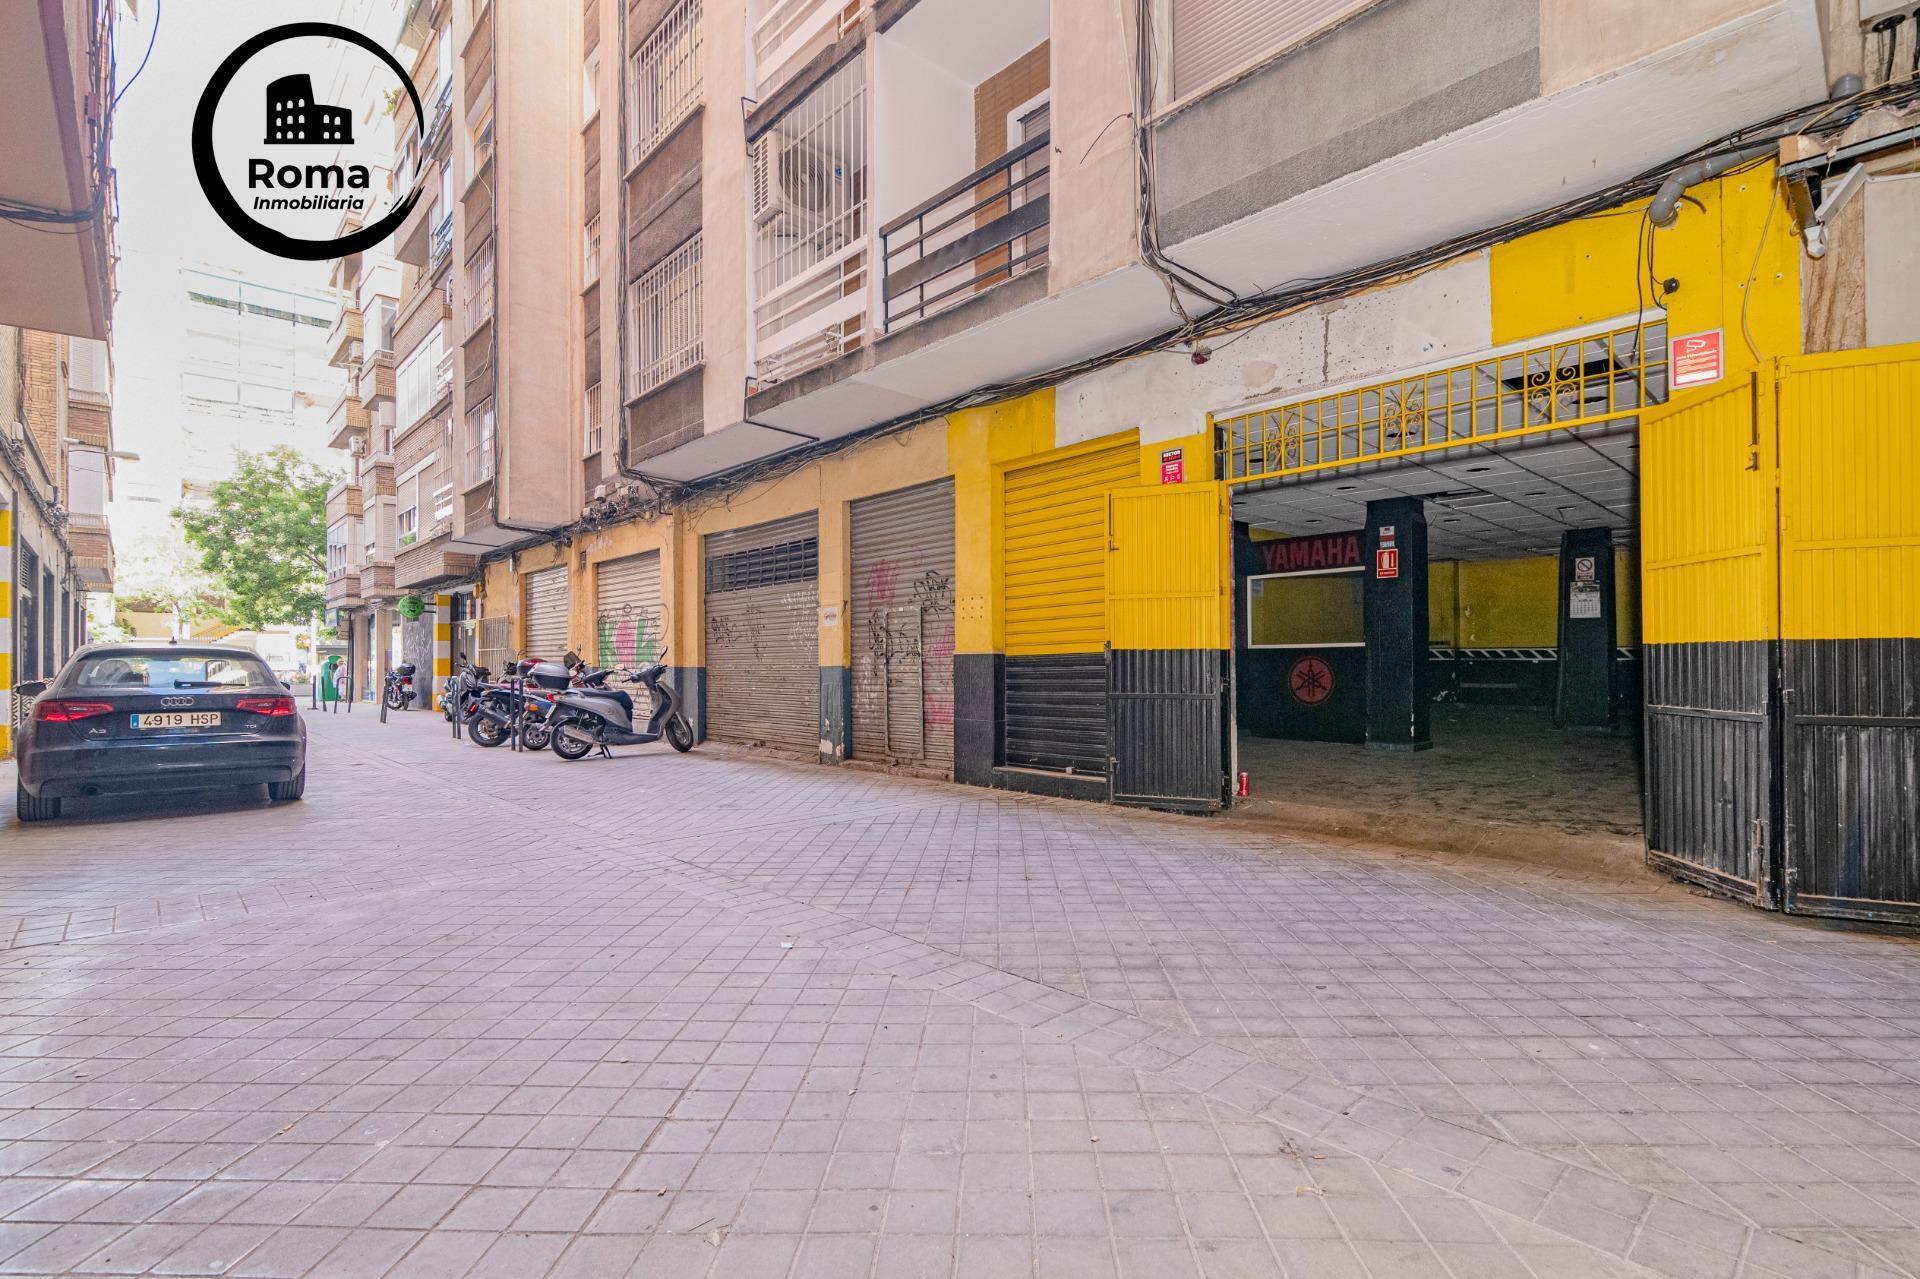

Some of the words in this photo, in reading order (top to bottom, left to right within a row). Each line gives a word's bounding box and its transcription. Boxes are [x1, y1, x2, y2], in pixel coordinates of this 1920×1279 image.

[1262, 536, 1361, 571] YAMAHA
[143, 715, 183, 727] 4919
[190, 713, 219, 726] HSP
[88, 727, 107, 735] A3
